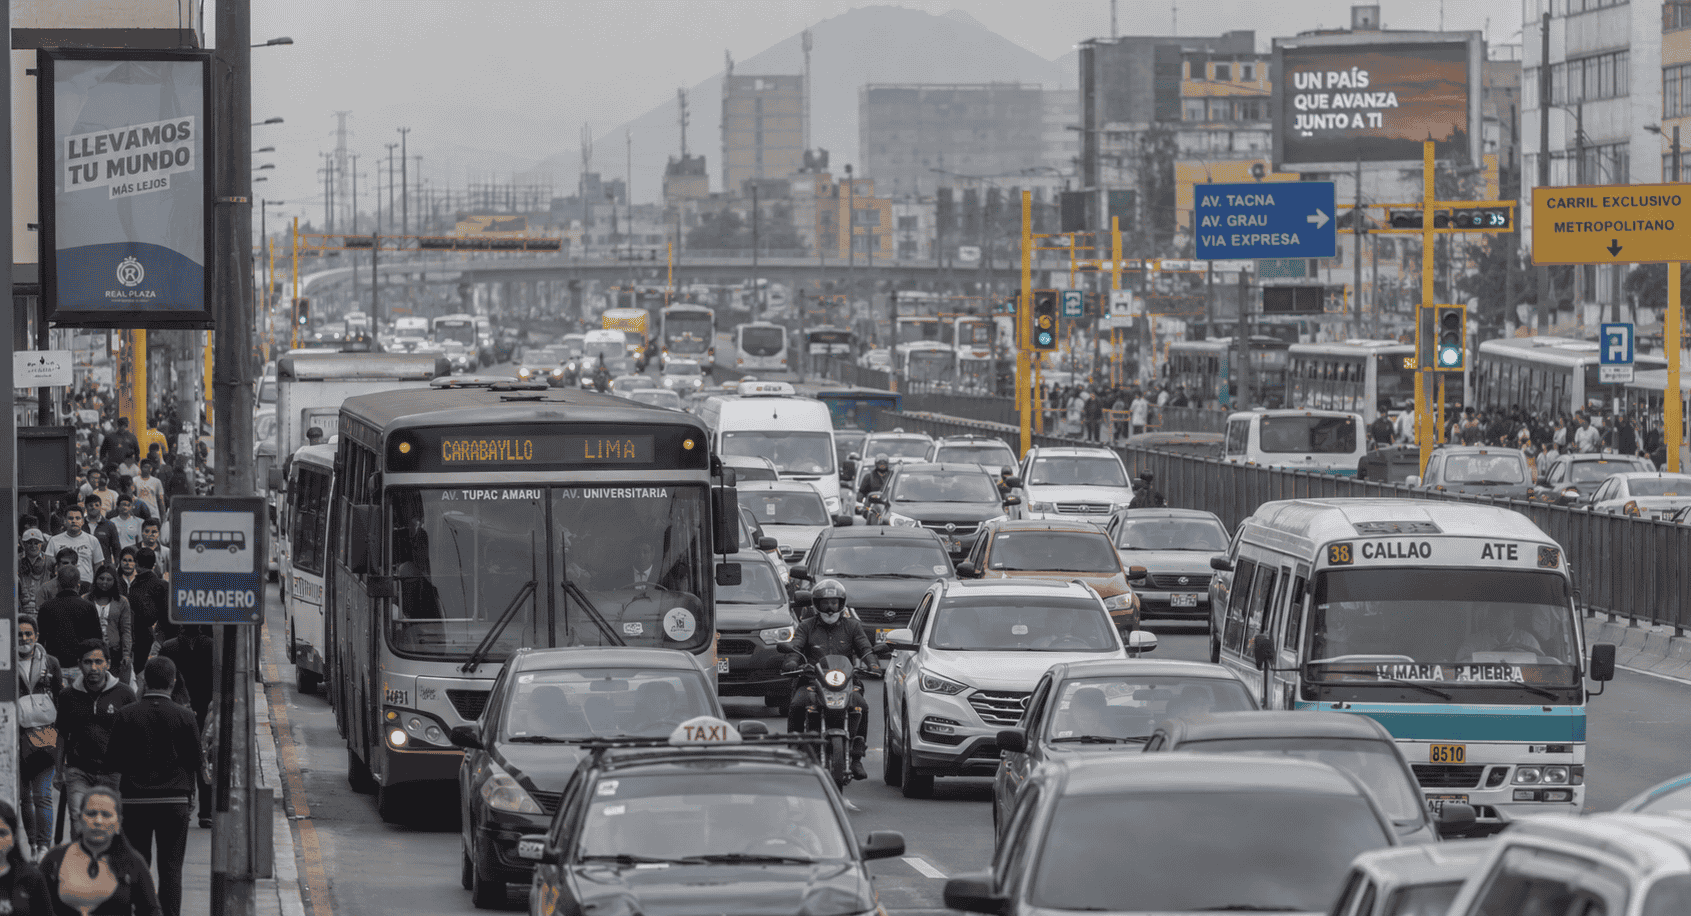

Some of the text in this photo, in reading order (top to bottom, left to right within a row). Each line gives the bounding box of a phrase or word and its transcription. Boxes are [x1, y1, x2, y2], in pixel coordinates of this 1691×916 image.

[1294, 66, 1369, 89] UN PAÍS
[1294, 92, 1398, 111] QUE AVANZA
[1294, 112, 1382, 129] JUNTO A TI
[69, 121, 191, 160] LLEVAMOS
[68, 146, 190, 184] TU MUNDO
[112, 178, 167, 197] MÁS LEJOS
[1201, 194, 1275, 207] AV. TACNA
[1546, 195, 1682, 209] CARRIL EXCLUSIVO
[1201, 214, 1267, 227] AV. GRAU
[1554, 219, 1675, 233] METROPOLITANO
[1201, 233, 1300, 247] VIA EXPRESA
[105, 290, 156, 298] REAL PLAZA
[442, 439, 636, 461] CARABAYLLO LIMA
[442, 489, 541, 500] AV. TUPAC AMARU
[562, 489, 580, 499] AV.
[1330, 545, 1350, 563] 38
[1362, 541, 1432, 559] CALLAO
[1481, 543, 1518, 560] ATE
[178, 589, 255, 608] PARADERO
[684, 725, 727, 741] TAXI
[1432, 746, 1464, 762] 8510
